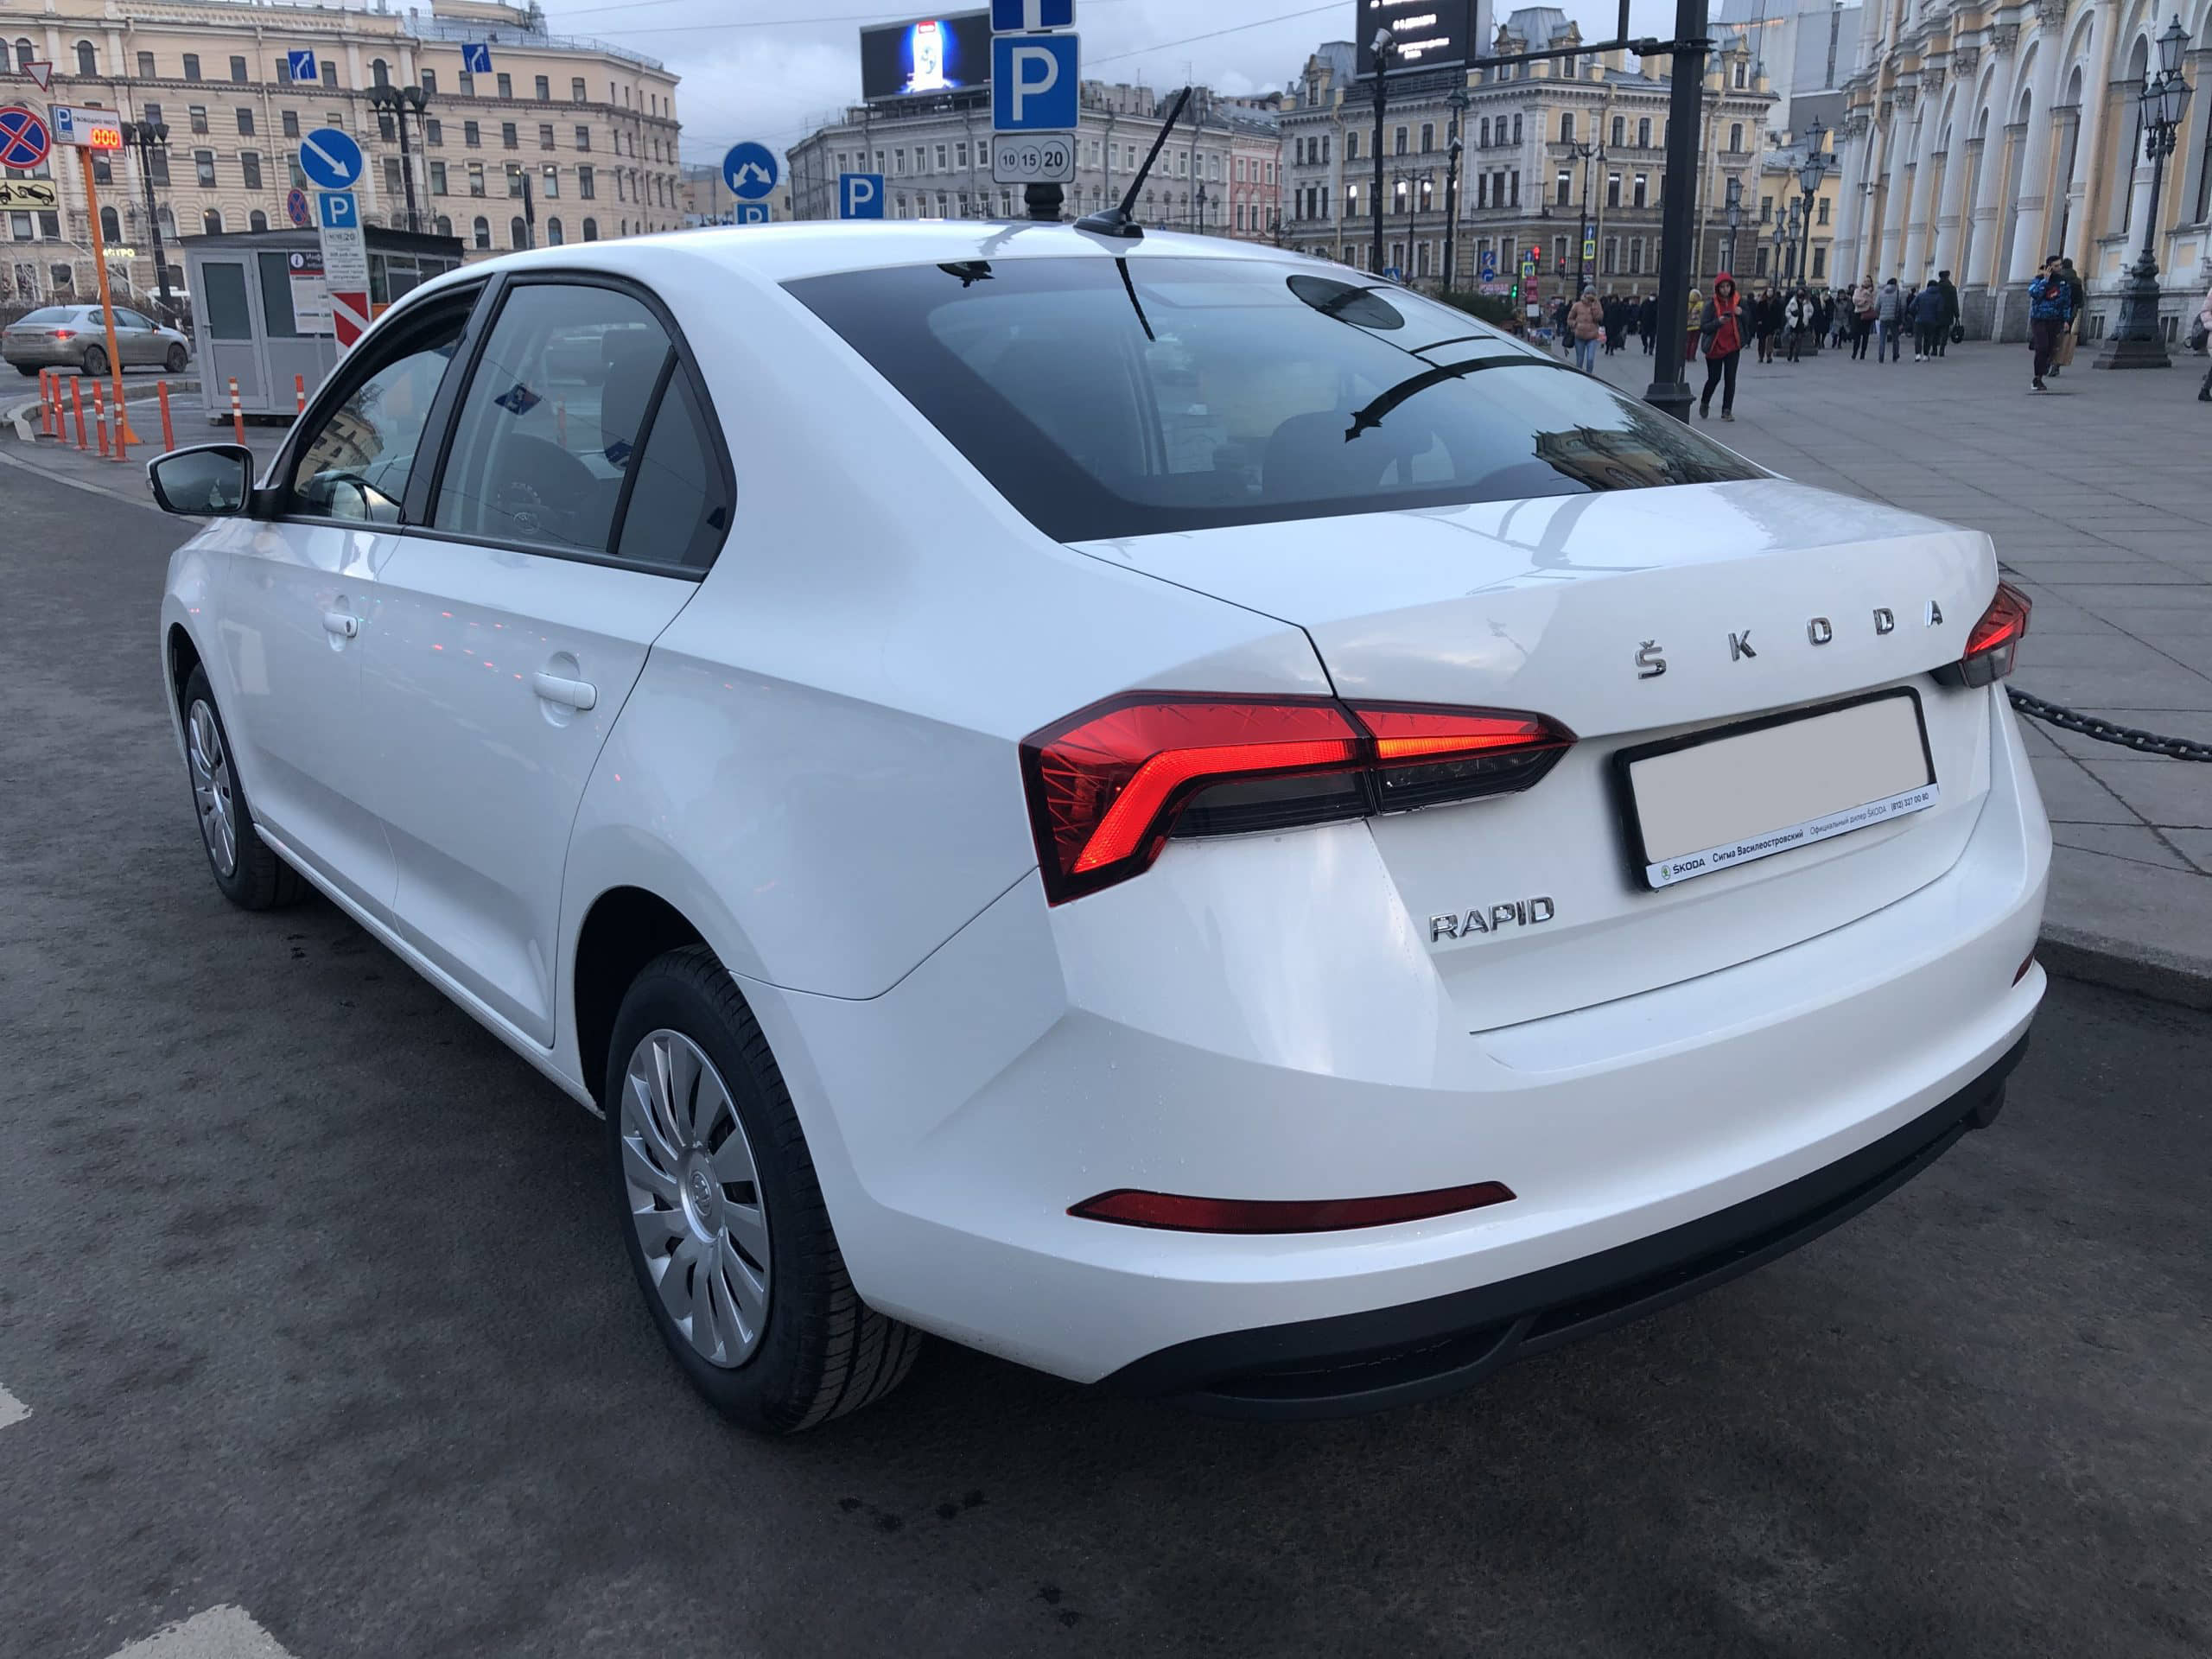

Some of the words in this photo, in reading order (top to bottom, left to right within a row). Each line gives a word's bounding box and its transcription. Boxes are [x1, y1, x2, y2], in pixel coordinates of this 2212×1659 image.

[1012, 46, 1059, 122] P
[1002, 154, 1015, 167] 10
[1021, 154, 1037, 167] 15
[1044, 150, 1064, 168] 20
[329, 196, 349, 225] P
[849, 178, 874, 216] P
[1672, 858, 1706, 875] ŠKODA
[1713, 850, 1736, 863] Сигма
[1737, 829, 1804, 856] Василеостровский
[1429, 896, 1555, 943] RAPID
